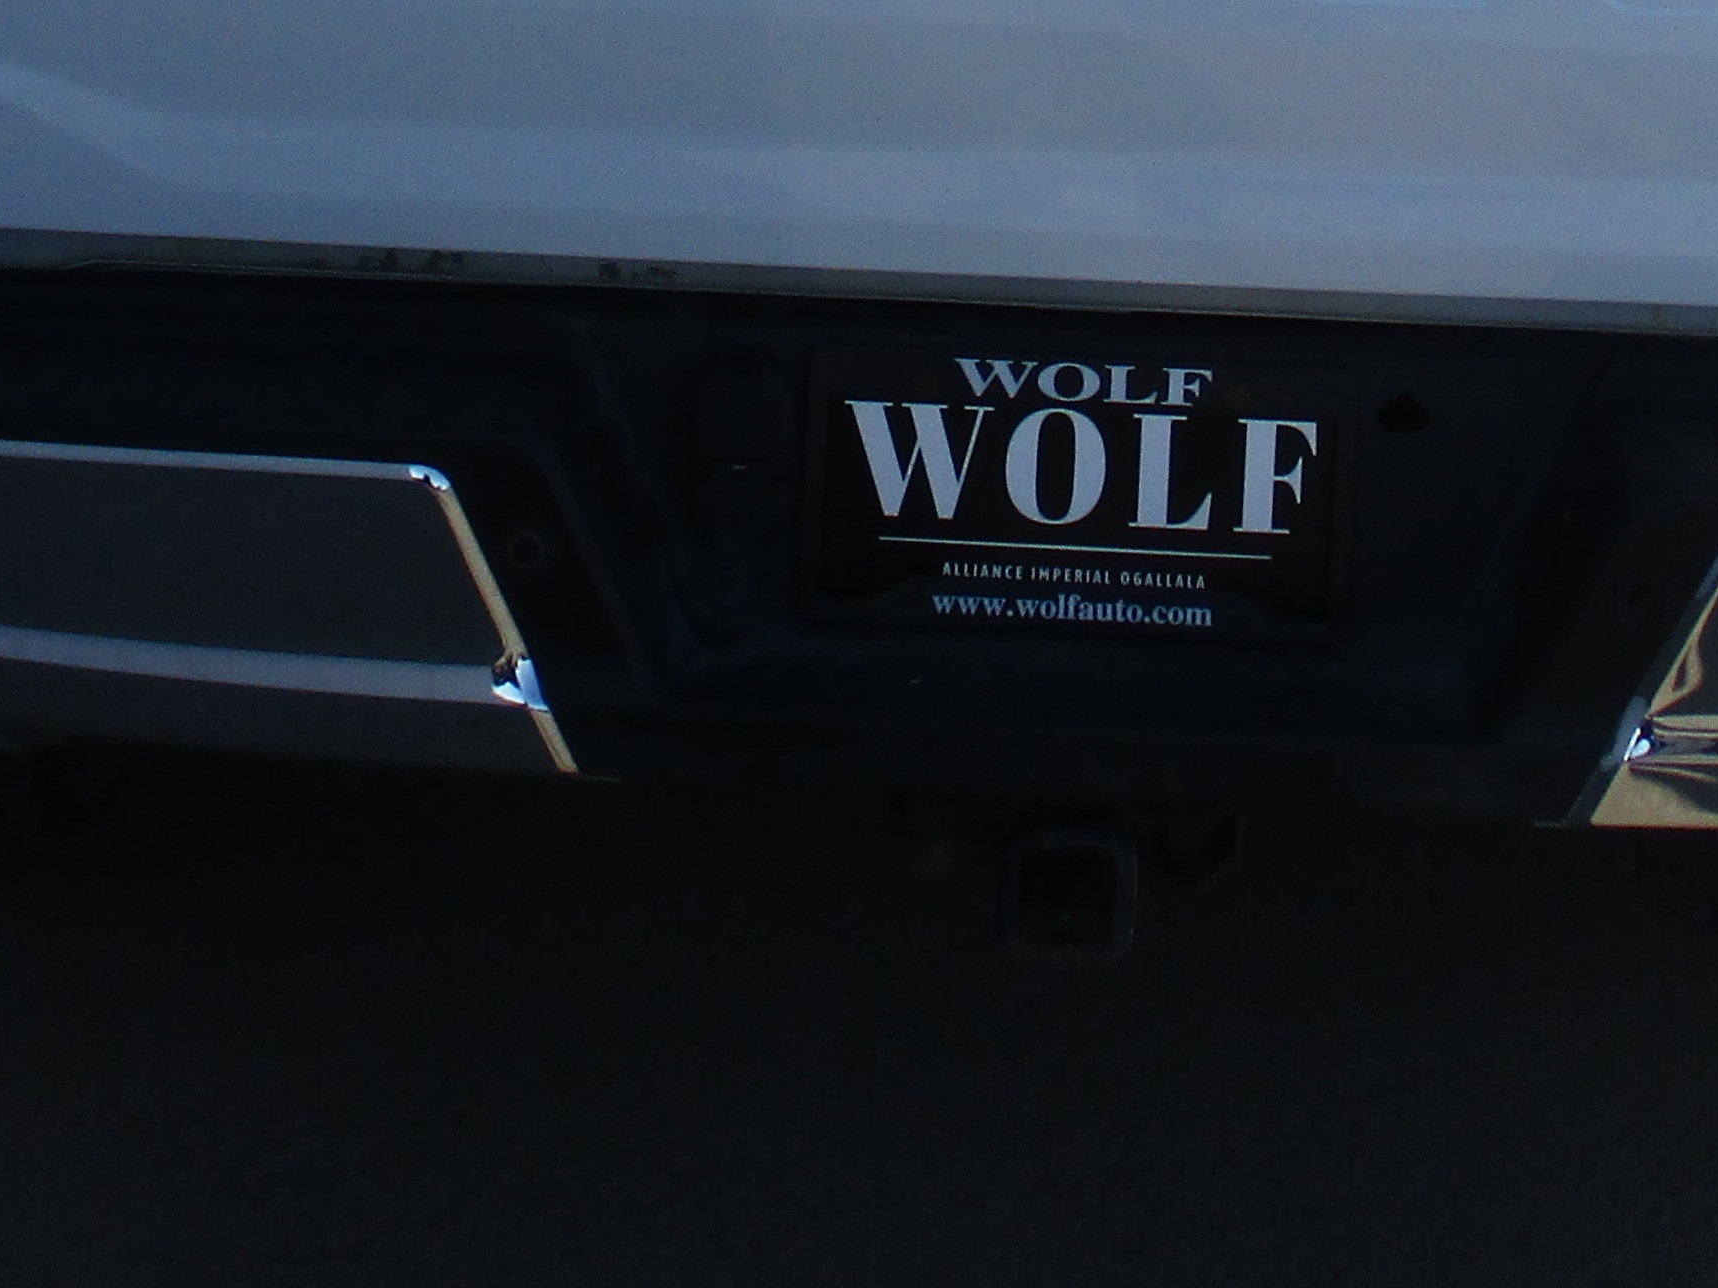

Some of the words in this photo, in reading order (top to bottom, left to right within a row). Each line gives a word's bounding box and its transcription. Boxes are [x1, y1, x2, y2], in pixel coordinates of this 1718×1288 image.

[953, 356, 1214, 408] WOLF
[843, 399, 1319, 535] WOLF
[941, 561, 1024, 581] ALLIANCE
[1030, 565, 1111, 586] IMPERIAL
[1120, 570, 1207, 591] OGALLALA
[931, 591, 1214, 628] www.wolfauto.com
